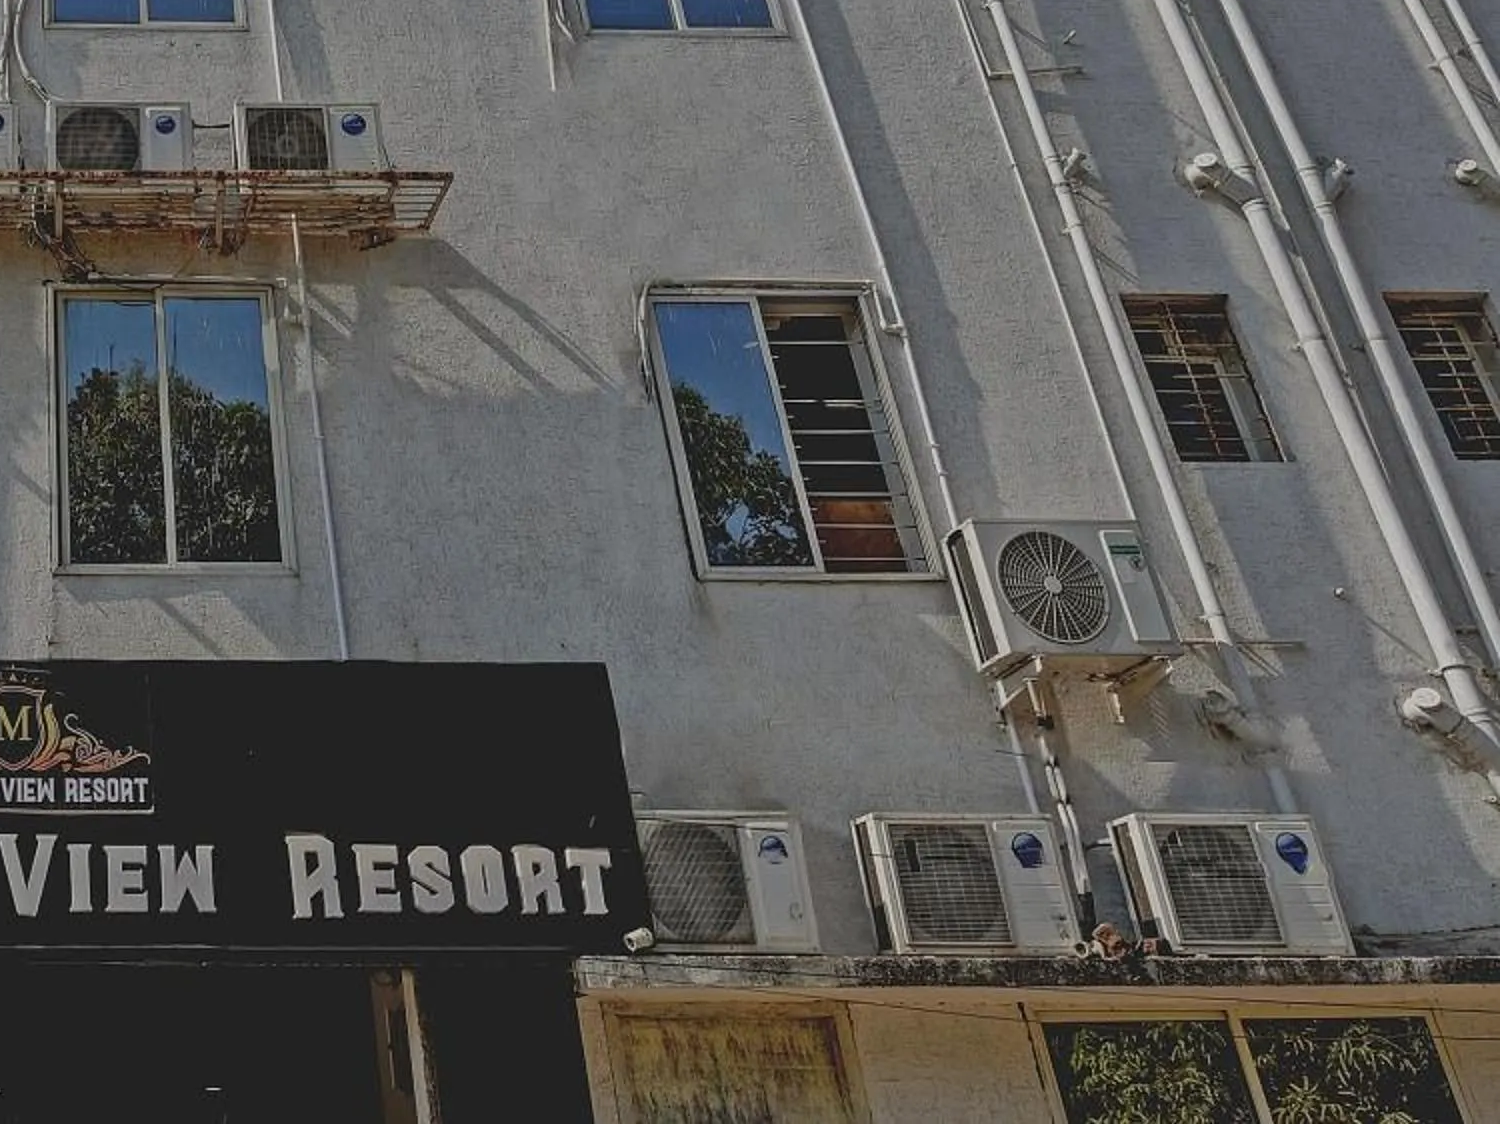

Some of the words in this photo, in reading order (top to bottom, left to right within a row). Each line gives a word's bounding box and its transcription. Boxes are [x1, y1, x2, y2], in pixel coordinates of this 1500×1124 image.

[1, 777, 56, 804] VIEW
[64, 776, 149, 804] RESORT
[284, 831, 612, 919] RESORT
